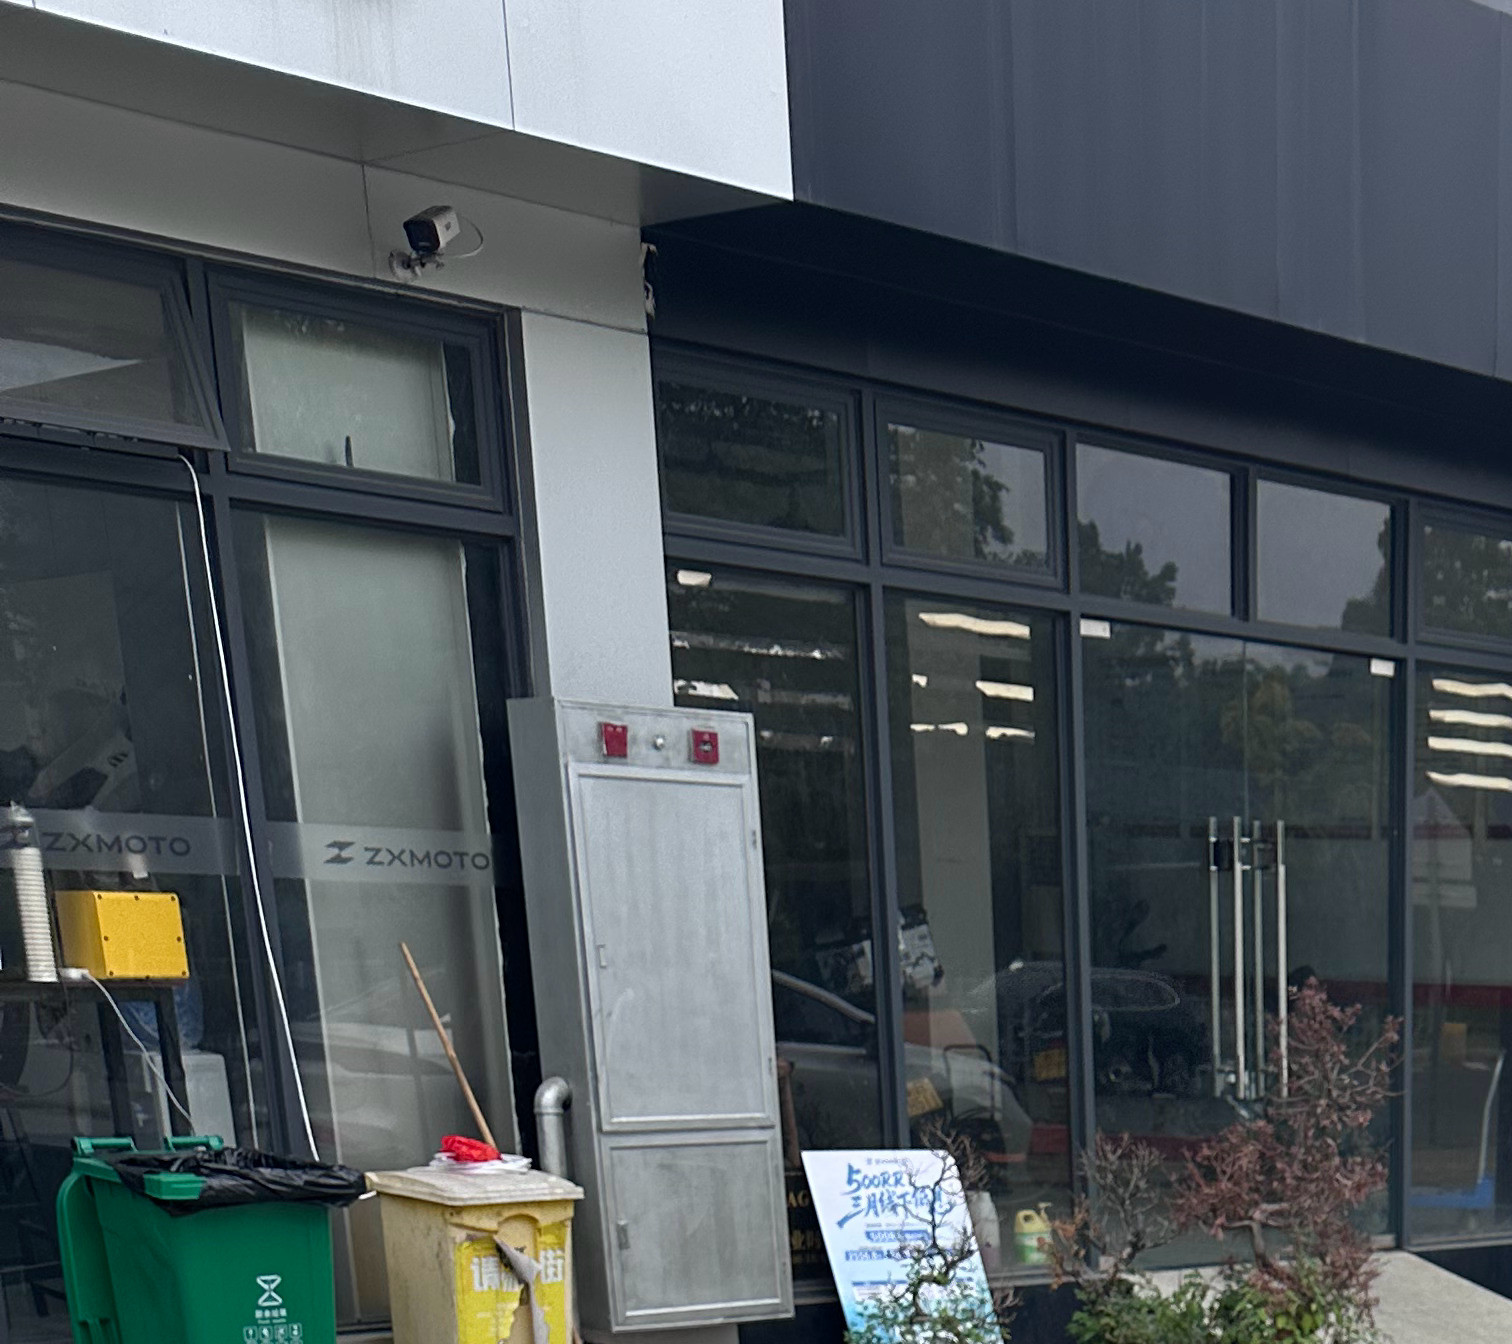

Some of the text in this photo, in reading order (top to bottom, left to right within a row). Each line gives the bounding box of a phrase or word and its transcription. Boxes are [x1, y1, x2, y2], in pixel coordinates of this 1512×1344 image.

[42, 831, 191, 857] ZXMOTO
[363, 845, 490, 871] ZXMOTO
[841, 1162, 907, 1196] 500RR
